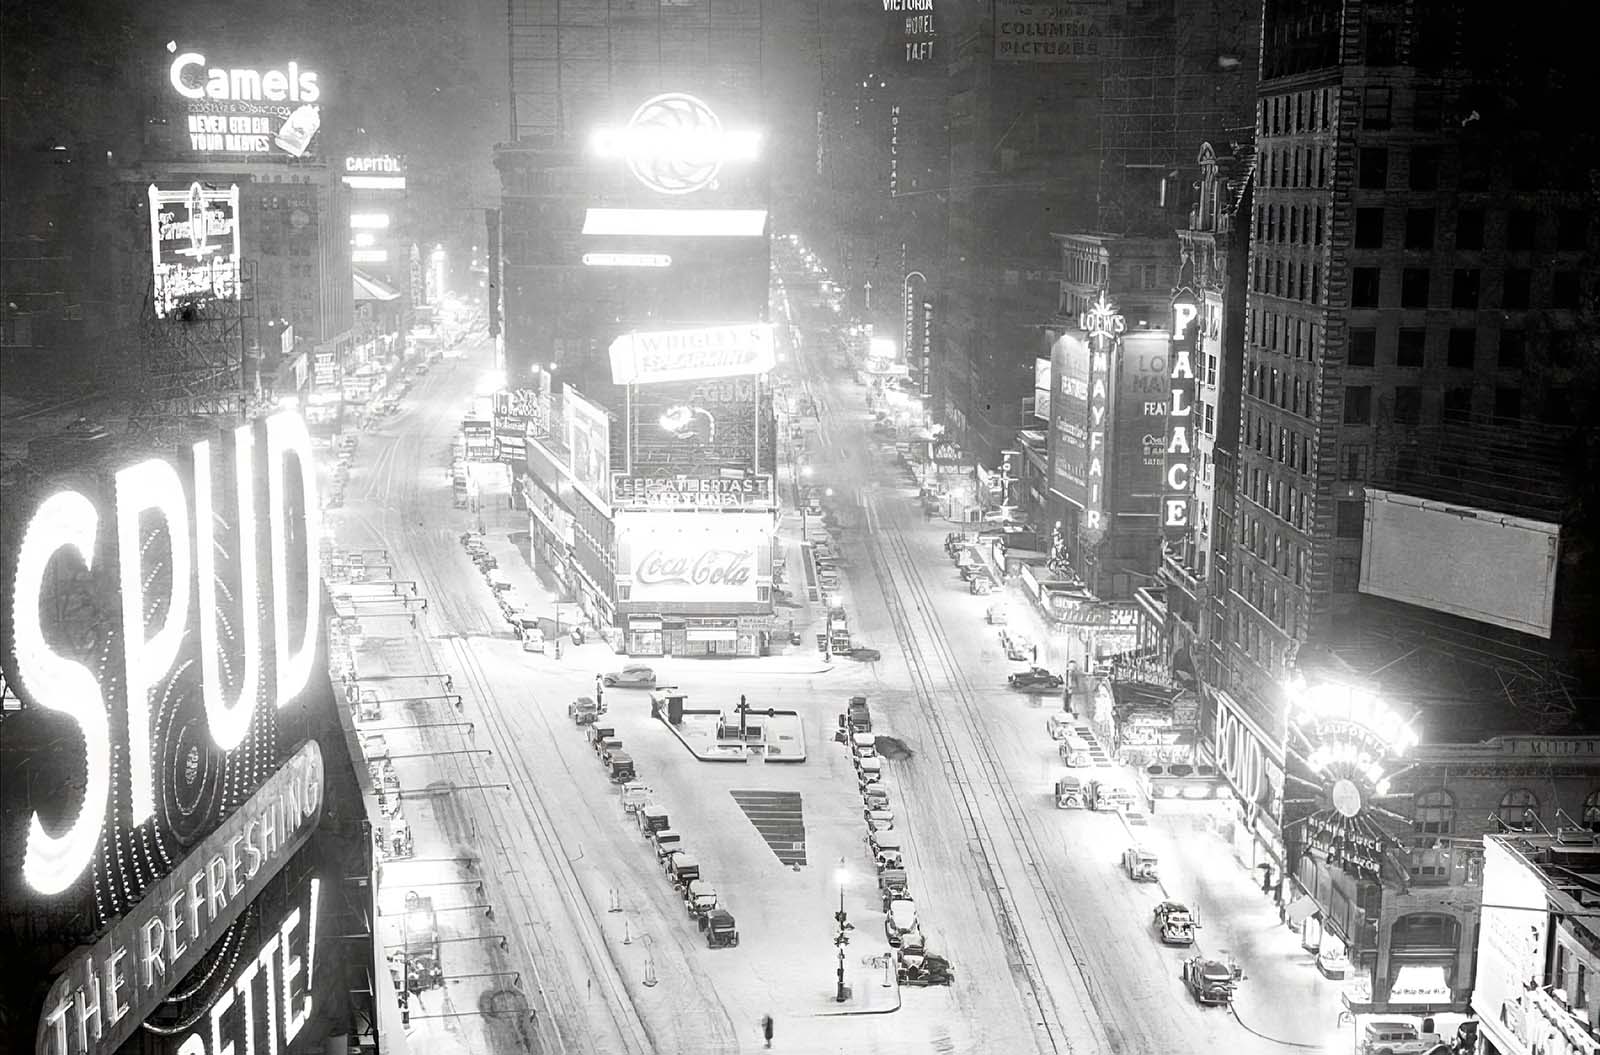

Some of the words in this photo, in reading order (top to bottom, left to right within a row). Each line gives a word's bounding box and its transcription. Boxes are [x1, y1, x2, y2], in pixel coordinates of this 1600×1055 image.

[906, 41, 934, 62] TAFT
[1000, 22, 1097, 36] COLUMBIA
[1000, 41, 1098, 56] PICTURES
[169, 52, 321, 102] Camels
[345, 155, 401, 172] CAPITOL
[1080, 313, 1125, 334] LOEW'S
[1087, 351, 1109, 529] MAYFAIR
[1166, 303, 1198, 527] PALACE
[12, 410, 322, 896] SPUD
[1215, 699, 1262, 803] BOND
[46, 946, 132, 1055] THE
[140, 762, 321, 989] REFRESHING
